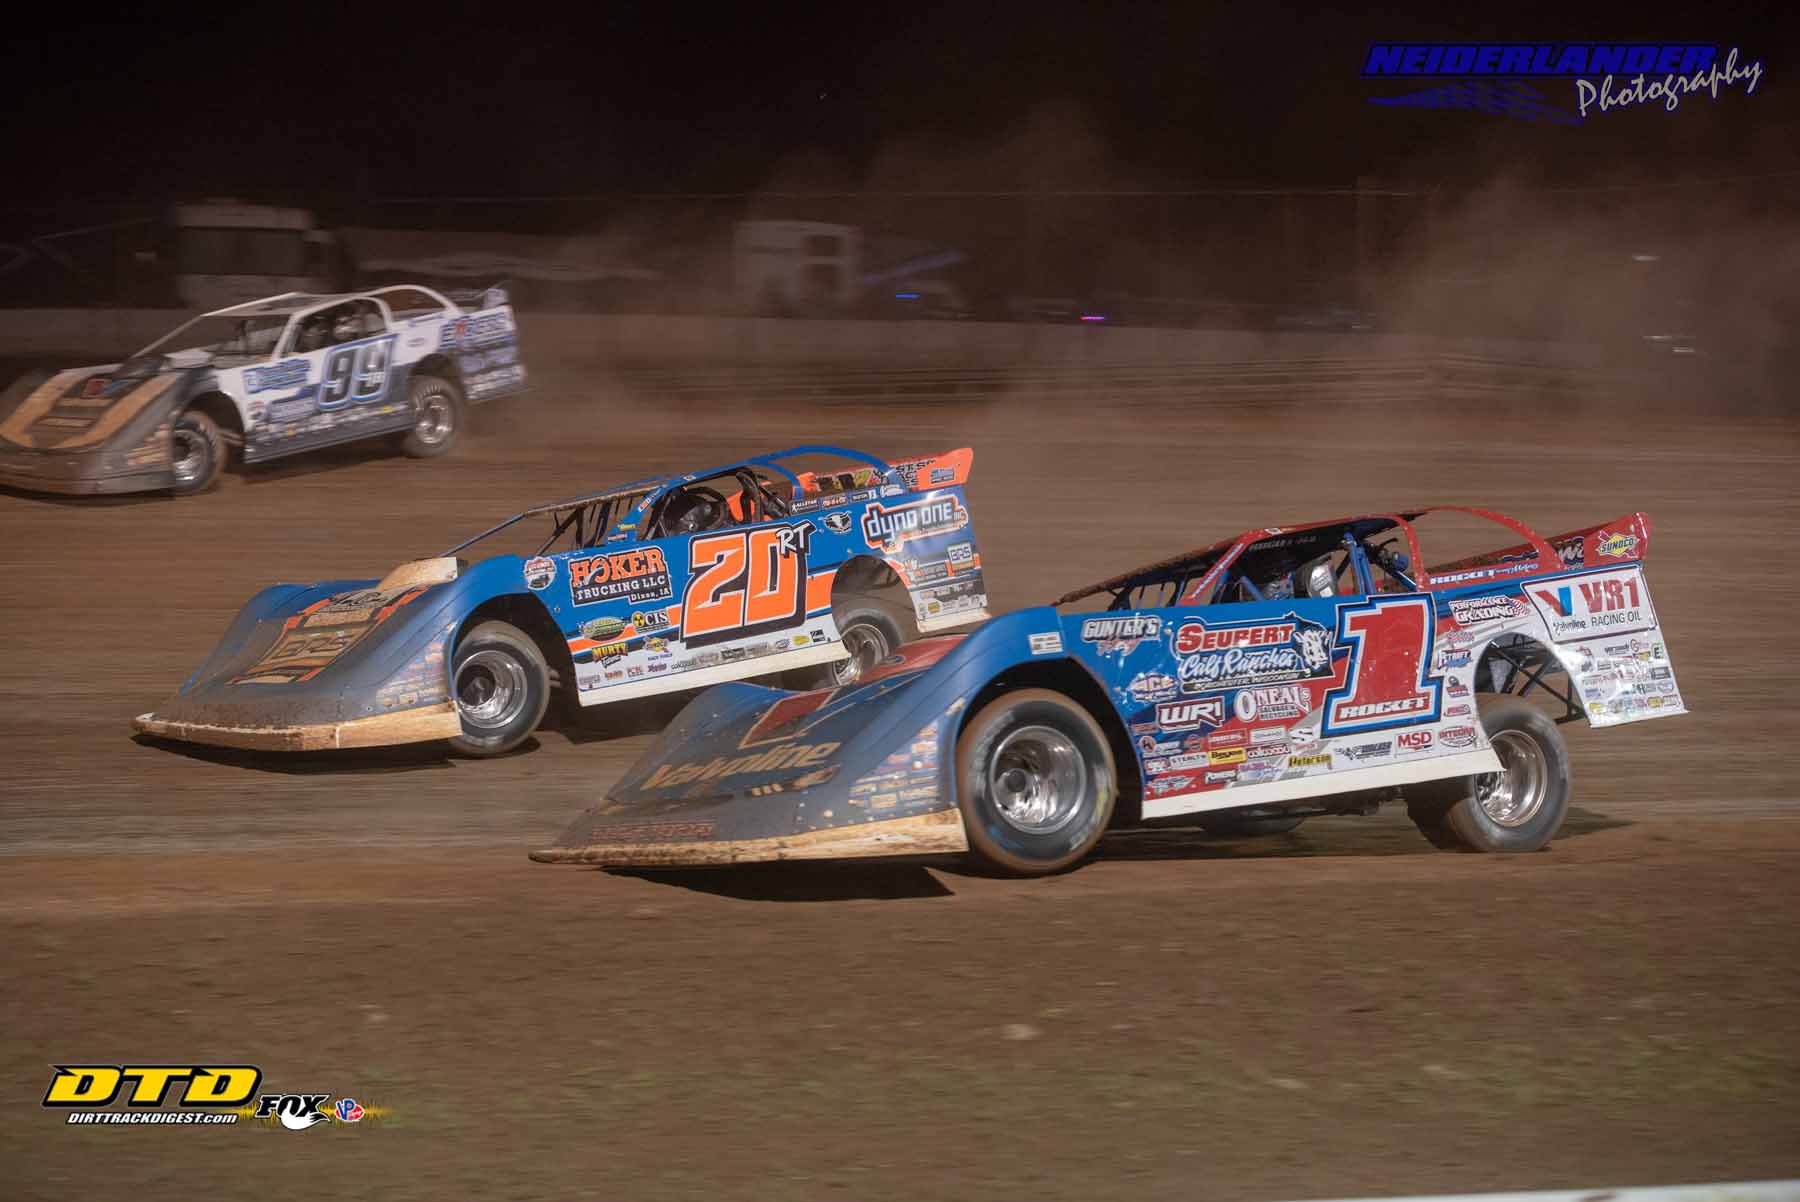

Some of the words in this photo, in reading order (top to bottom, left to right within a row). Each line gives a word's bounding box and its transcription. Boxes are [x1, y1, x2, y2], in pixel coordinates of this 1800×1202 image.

[317, 334, 397, 411] 99
[1600, 537, 1634, 553] SUNOCO
[576, 581, 640, 600] TRUCKING
[642, 575, 666, 588] LLC
[1578, 577, 1640, 613] VR1
[645, 611, 668, 626] CIS
[1591, 613, 1625, 627] RACING
[1627, 611, 1643, 623] OIL
[1327, 598, 1439, 733] 1
[1339, 697, 1429, 719] ROCKET
[1397, 731, 1432, 747] MSD
